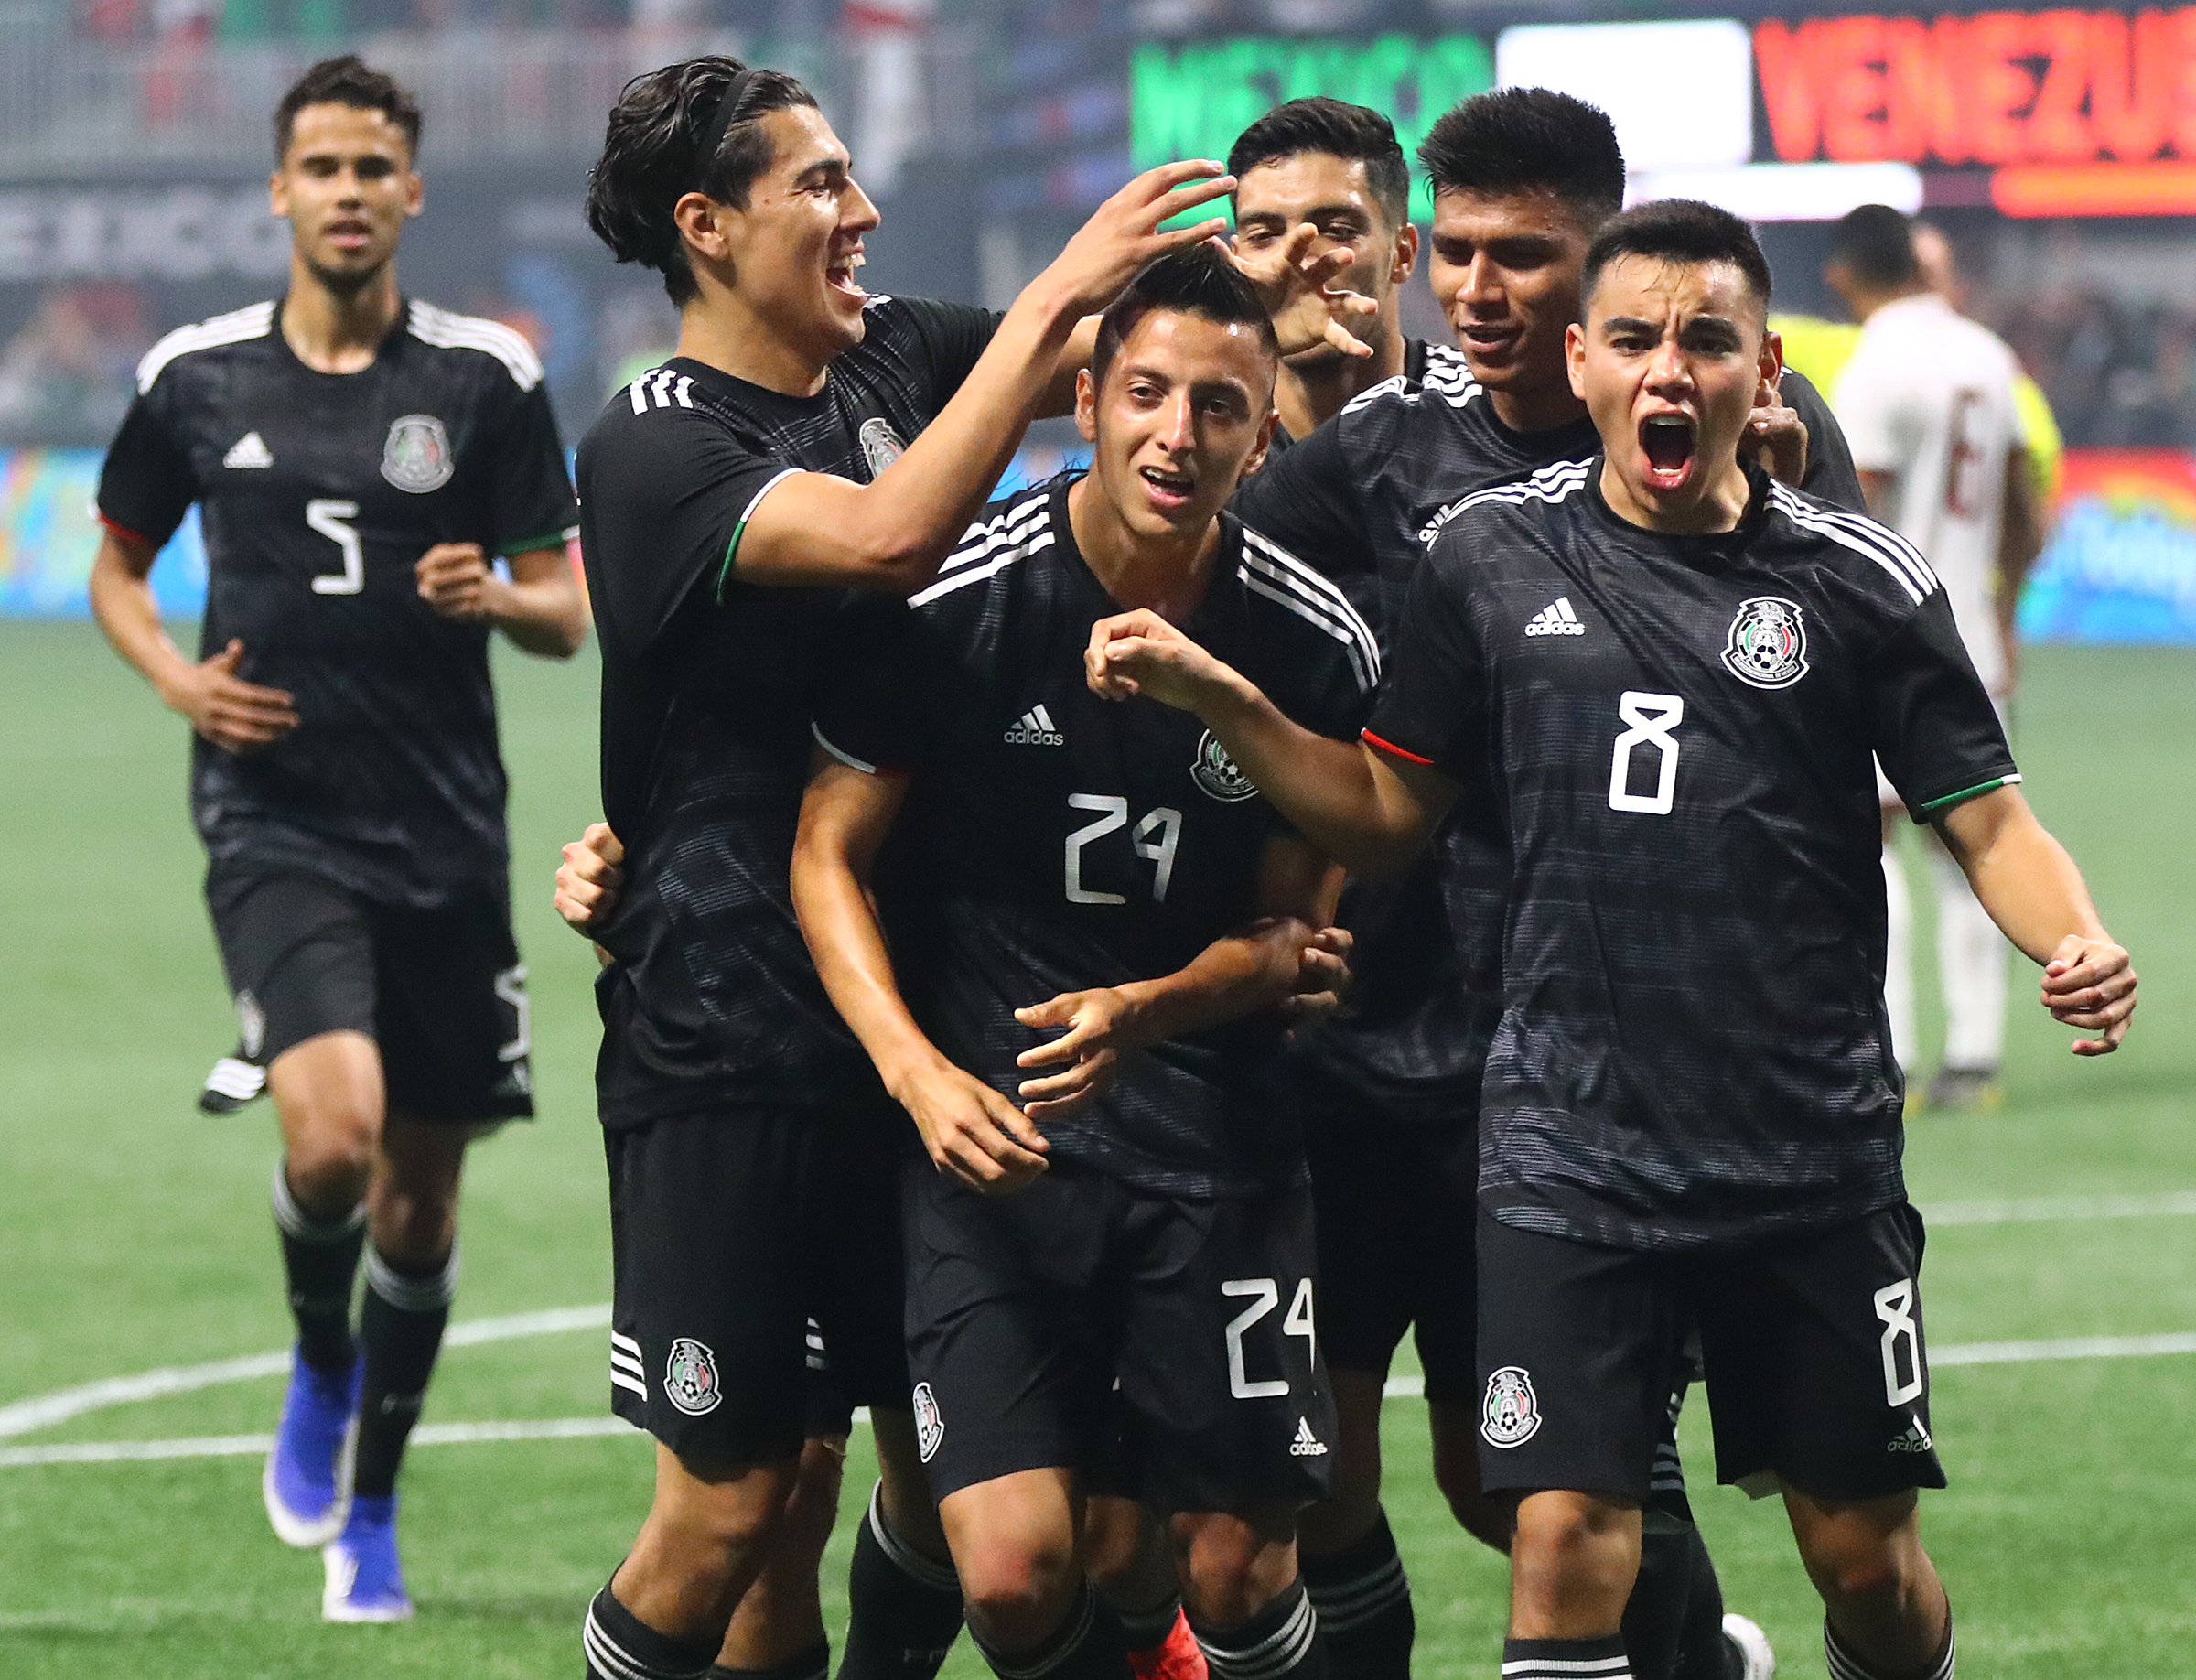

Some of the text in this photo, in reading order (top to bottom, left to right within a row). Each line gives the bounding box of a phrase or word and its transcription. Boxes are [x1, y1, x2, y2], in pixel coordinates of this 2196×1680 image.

[306, 498, 364, 595] 5
[1524, 619, 1585, 636] adidas
[1003, 728, 1064, 746] adidas
[1608, 690, 1685, 815] 8
[1221, 1277, 1317, 1399] 24
[1873, 1277, 1922, 1407] 8
